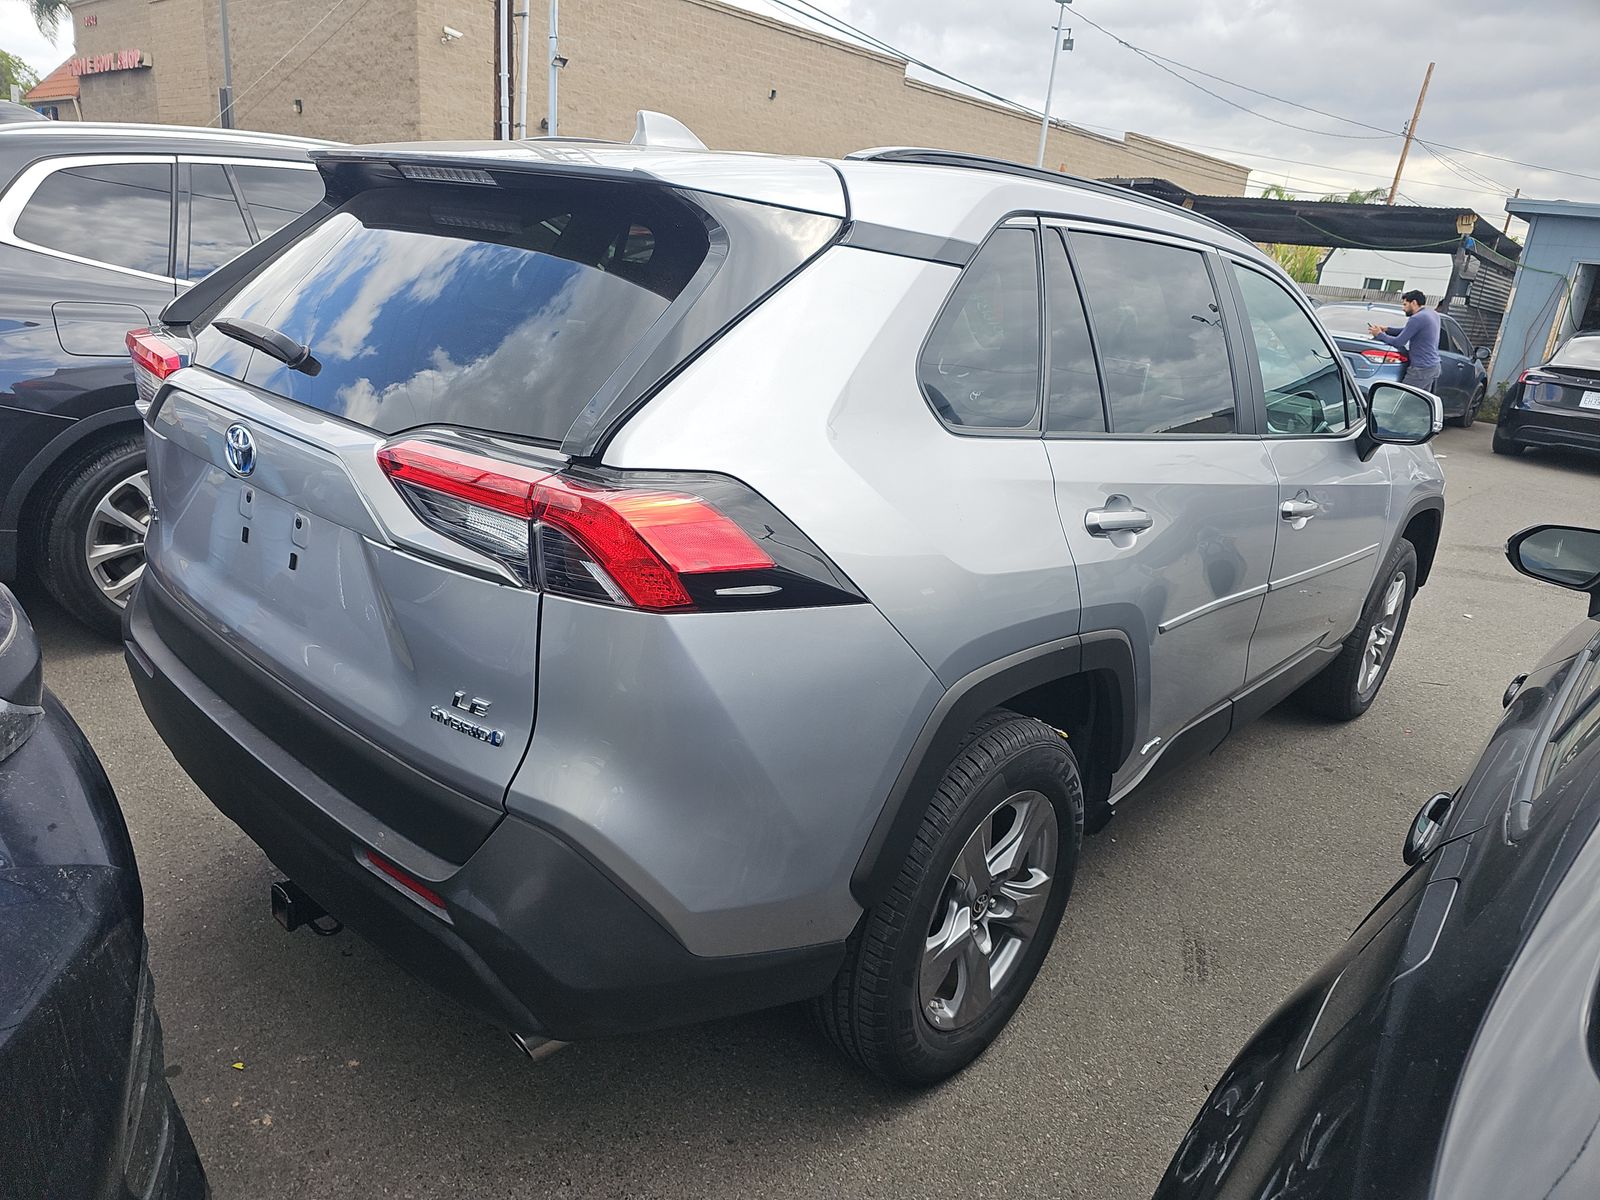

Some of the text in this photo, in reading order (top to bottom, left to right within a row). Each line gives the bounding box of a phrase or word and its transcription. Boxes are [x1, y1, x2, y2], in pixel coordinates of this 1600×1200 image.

[118, 48, 141, 70] SHOP
[452, 690, 493, 718] LE
[430, 705, 493, 742] HYBRID
